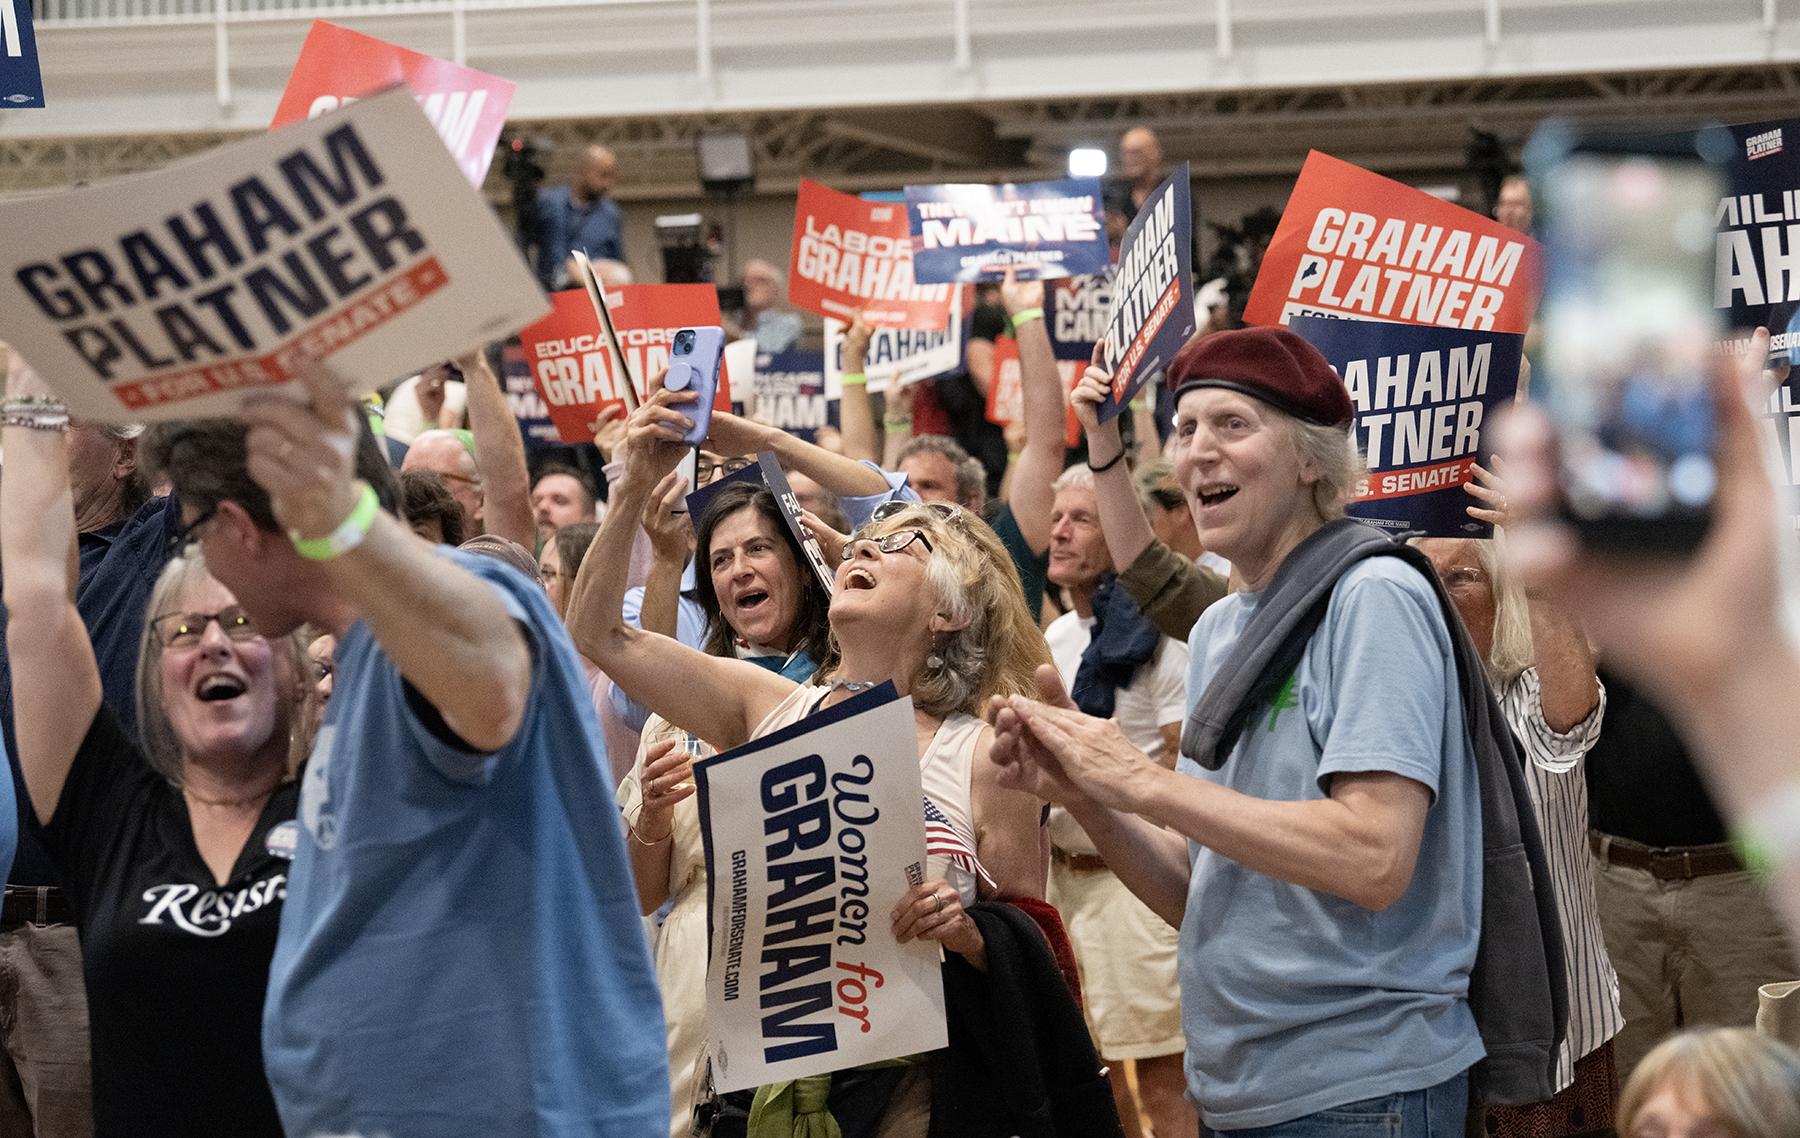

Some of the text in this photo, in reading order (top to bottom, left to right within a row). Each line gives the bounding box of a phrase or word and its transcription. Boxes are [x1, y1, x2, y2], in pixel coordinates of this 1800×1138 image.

[1745, 127, 1782, 148] GRAHAM
[1746, 137, 1783, 157] PLATNER
[15, 121, 385, 323] GRAHAM
[921, 213, 1099, 249] MAINE
[1306, 207, 1525, 287] GRAHAM
[62, 193, 428, 381] PLATNER
[1104, 231, 1179, 379] PLATNER
[1287, 253, 1505, 332] PLATNER
[1115, 363, 1132, 392] FOR
[1142, 290, 1175, 343] SENATE
[1337, 342, 1493, 413] AHAM
[1350, 401, 1484, 469] TNER
[1382, 464, 1460, 495] SENATE
[724, 849, 747, 1002] GRAHAMFORSENATE.COM
[760, 753, 838, 1065] GRAHAM
[831, 755, 885, 1033] Women for
